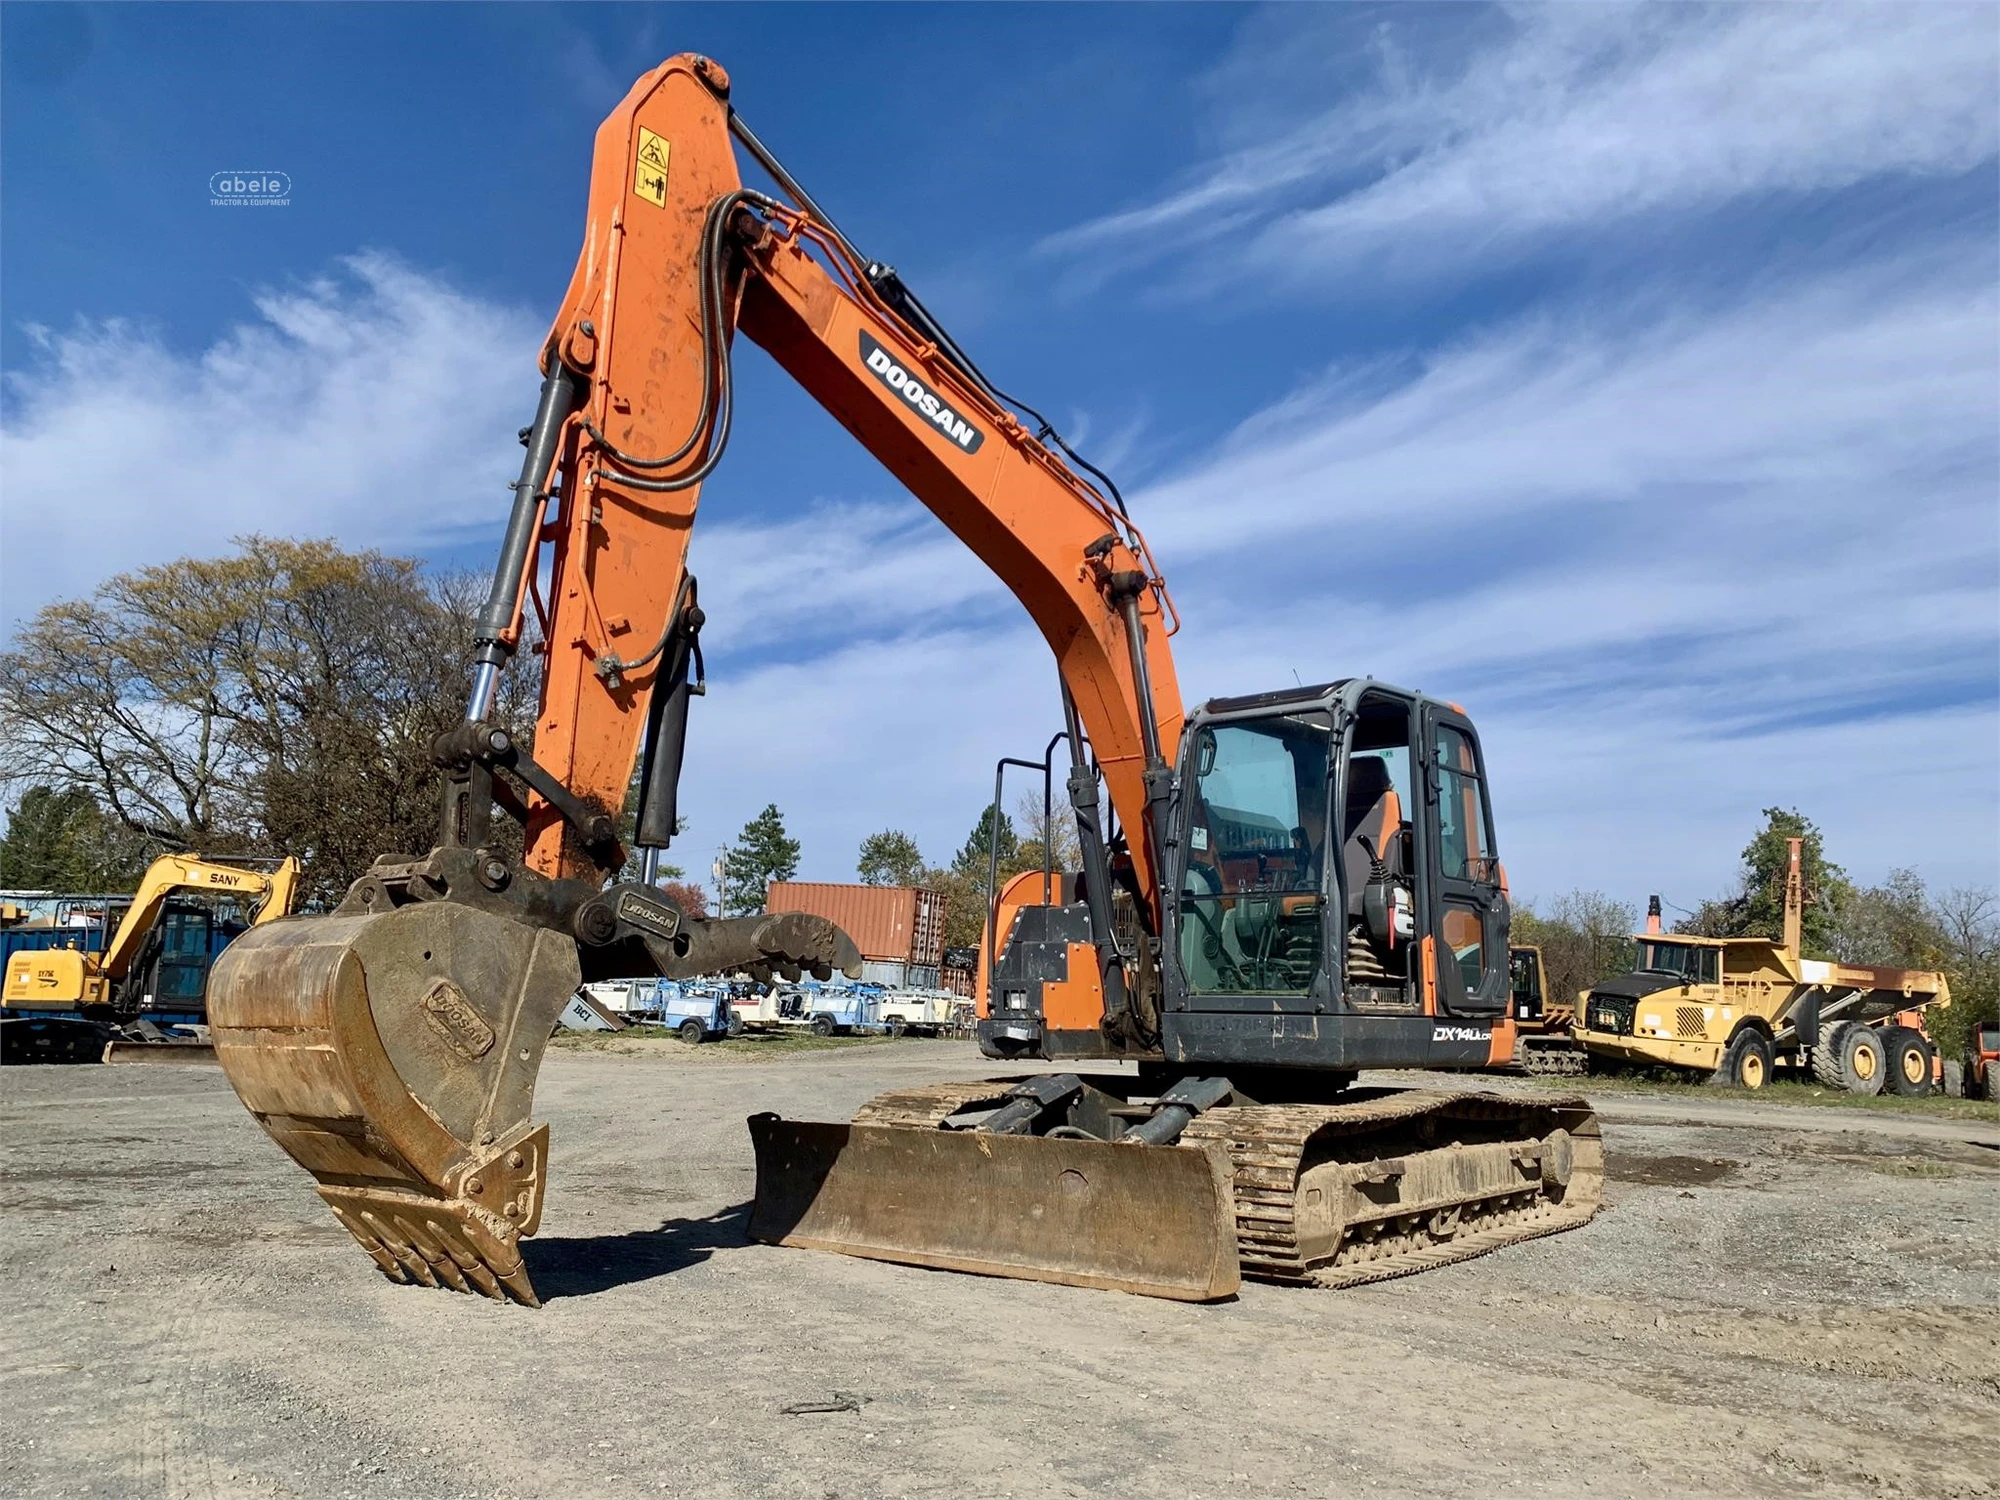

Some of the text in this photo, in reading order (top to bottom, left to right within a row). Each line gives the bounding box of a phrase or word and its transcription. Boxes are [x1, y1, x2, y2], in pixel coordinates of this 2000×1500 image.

[866, 347, 975, 447] DOOSAN
[210, 873, 240, 886] SANY
[624, 903, 675, 930] DOOSAN
[432, 993, 486, 1046] DOOSAN
[573, 1003, 592, 1022] BCI
